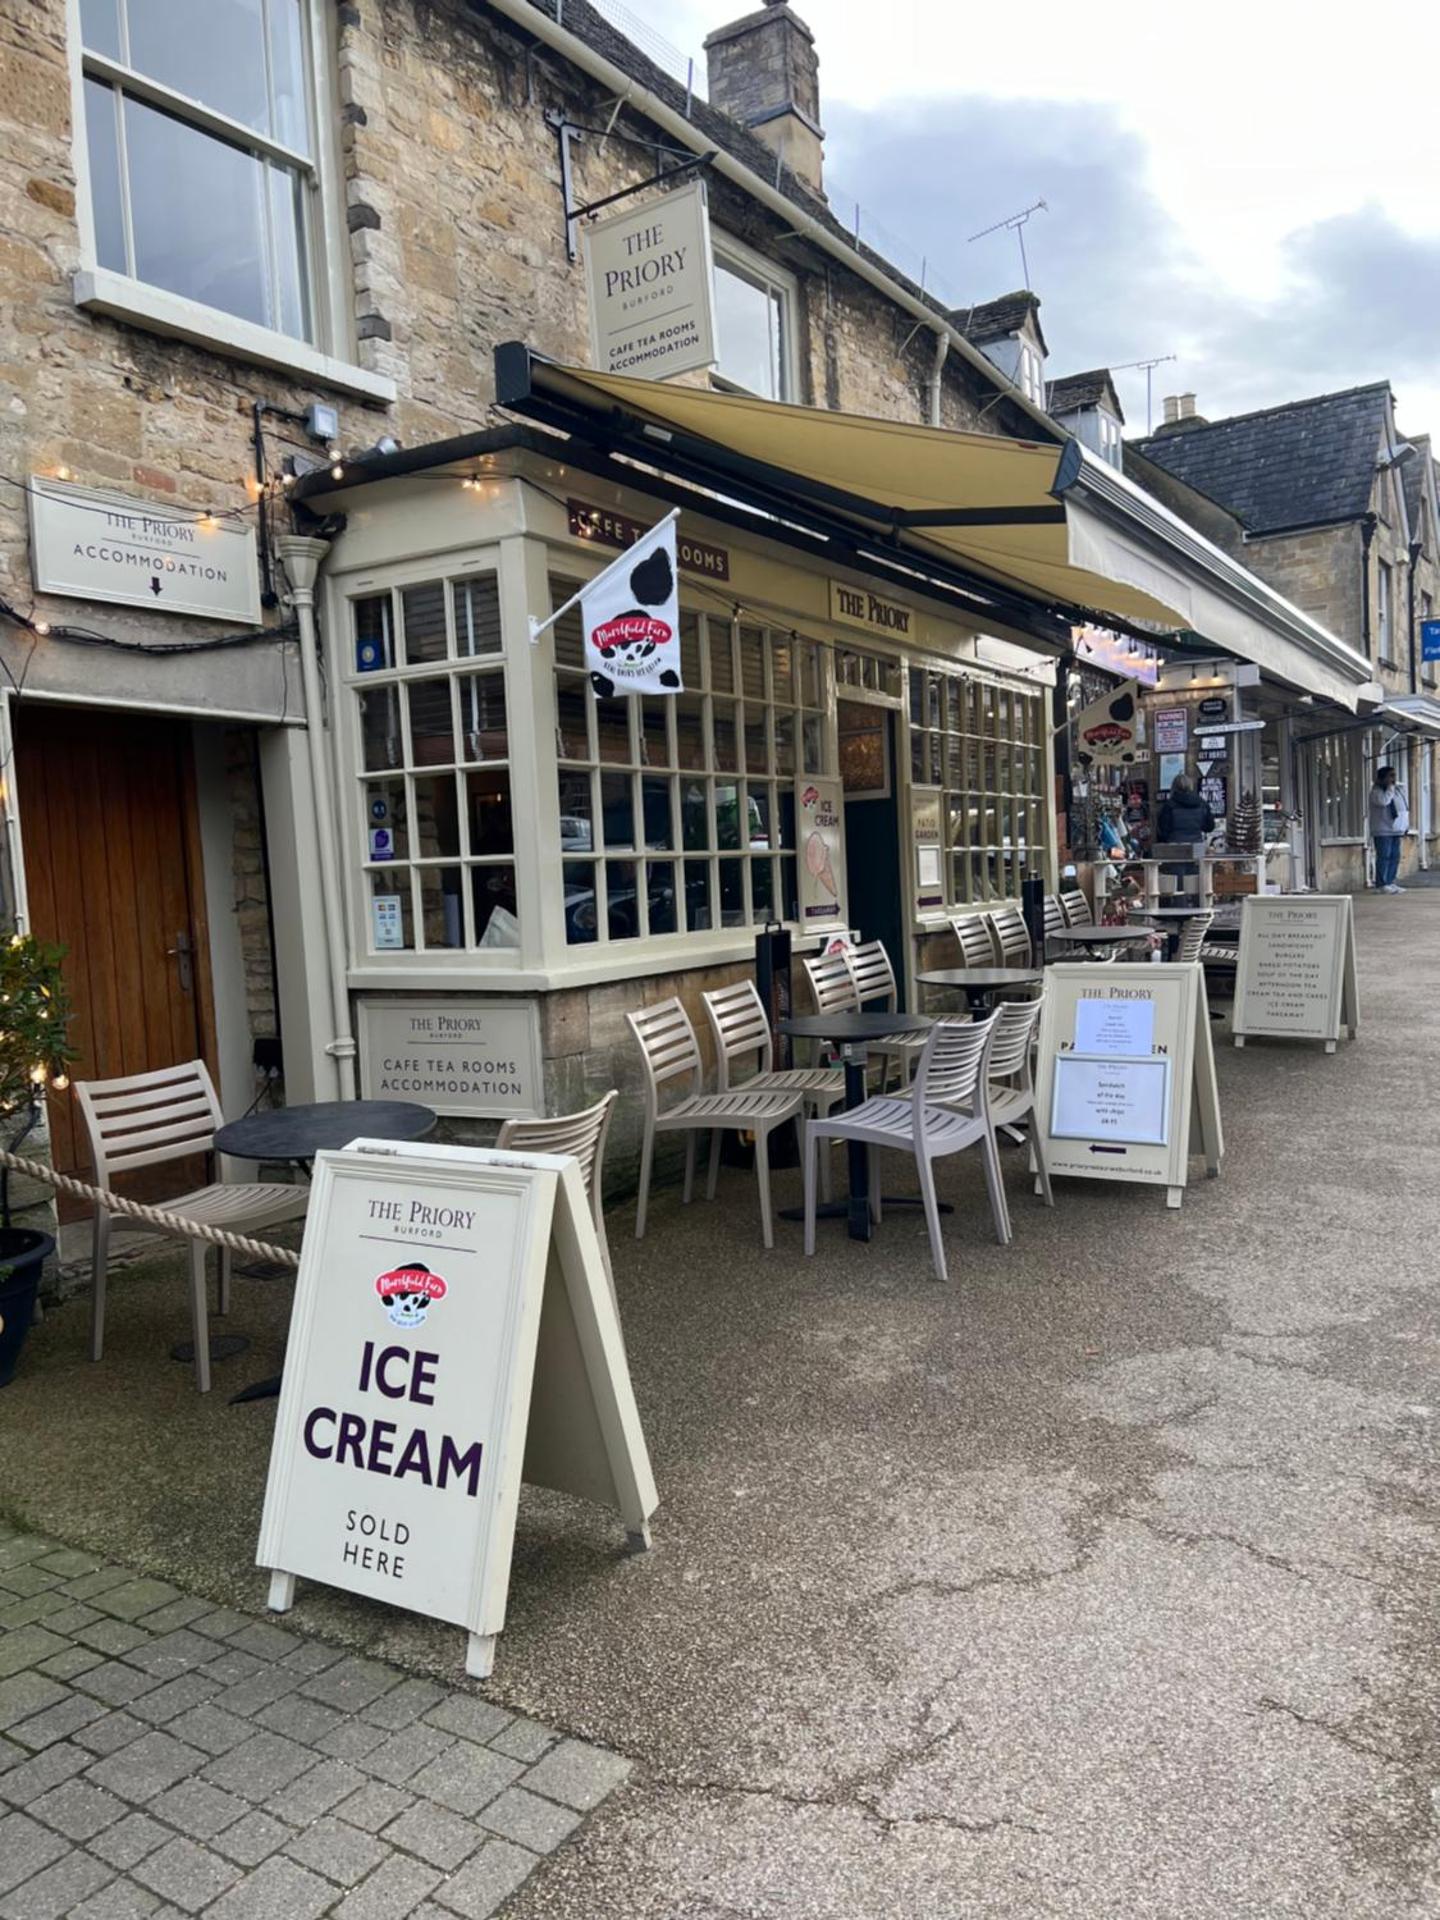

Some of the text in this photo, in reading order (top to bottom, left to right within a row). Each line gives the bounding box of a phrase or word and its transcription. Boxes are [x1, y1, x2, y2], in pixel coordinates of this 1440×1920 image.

[622, 223, 664, 257] THE
[604, 247, 688, 299] PRIORY
[622, 285, 674, 311] BURFORD
[608, 335, 699, 372] ACCOMMODATION
[609, 320, 696, 358] CAFE TEA ROOMS
[106, 512, 196, 543] THE PRIORY
[73, 543, 228, 583] ACCOMMODATION
[678, 545, 724, 573] OOMS
[836, 587, 865, 620] THE
[866, 591, 910, 634] PRIORY
[815, 814, 840, 828] CREAM
[820, 800, 832, 813] ICE
[1081, 986, 1155, 1000] THE PRIORY
[409, 1015, 483, 1032] THE PRIORY
[383, 1058, 517, 1075] CAFE TEA ROOMS
[380, 1078, 522, 1096] ACCOMMODATION
[368, 1199, 477, 1231] THE PRIORY
[393, 1225, 443, 1239] BURFORD
[358, 1340, 440, 1407] ICE
[303, 1406, 484, 1498] CREAM
[345, 1509, 412, 1547] SOLD
[342, 1541, 406, 1580] HERE
